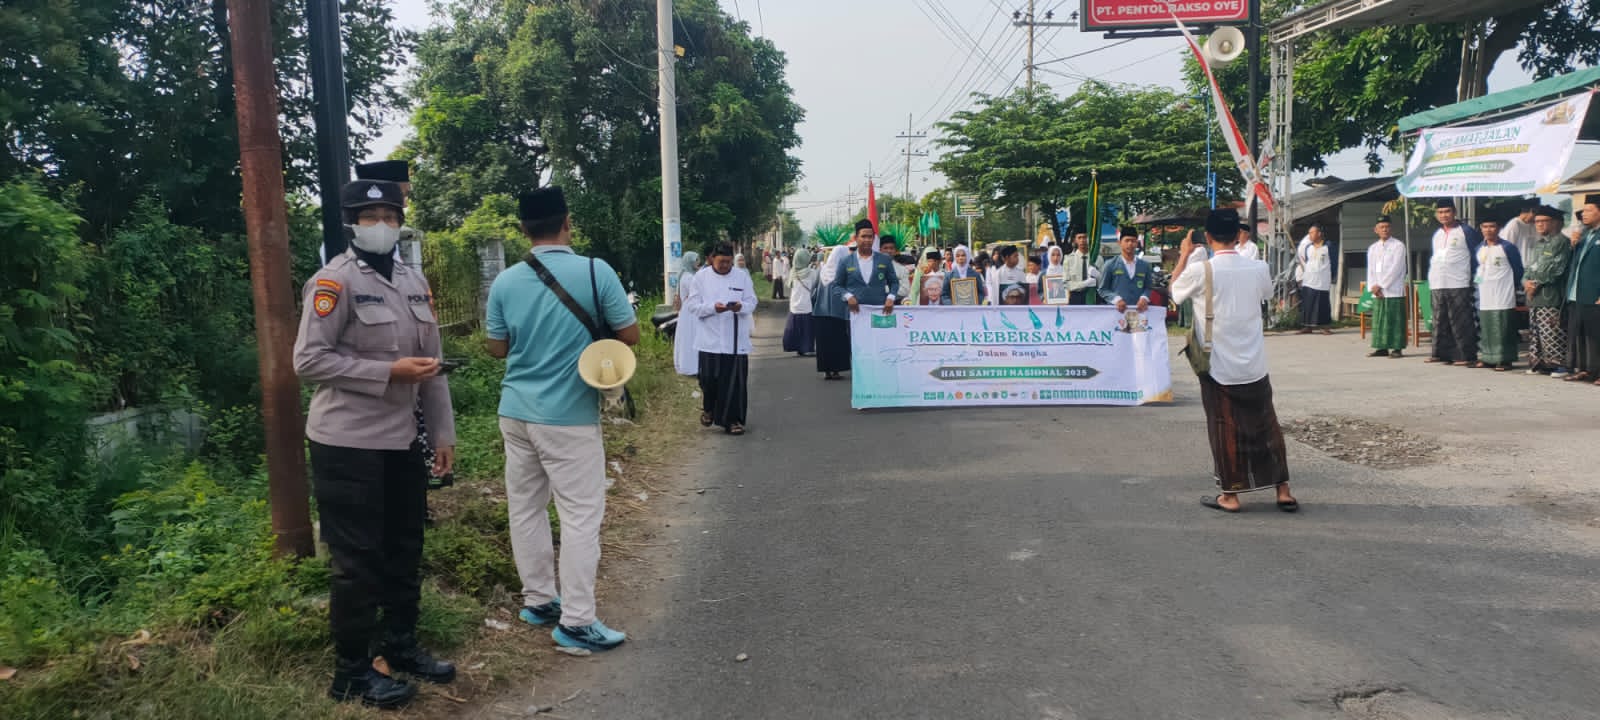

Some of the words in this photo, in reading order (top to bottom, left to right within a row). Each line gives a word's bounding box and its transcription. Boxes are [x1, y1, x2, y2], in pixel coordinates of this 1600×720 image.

[1096, 6, 1115, 16] PT.
[1118, 4, 1167, 16] PENTOL
[1214, 1, 1239, 10] OYE
[909, 330, 966, 343] PAWAI
[971, 330, 1113, 343] KEBERSAMAAN
[977, 349, 1008, 358] Dalam
[941, 369, 966, 378] HARI
[968, 369, 1007, 378] SANTRI
[1010, 368, 1063, 377] NASIONAL
[1065, 368, 1087, 377] 2025
